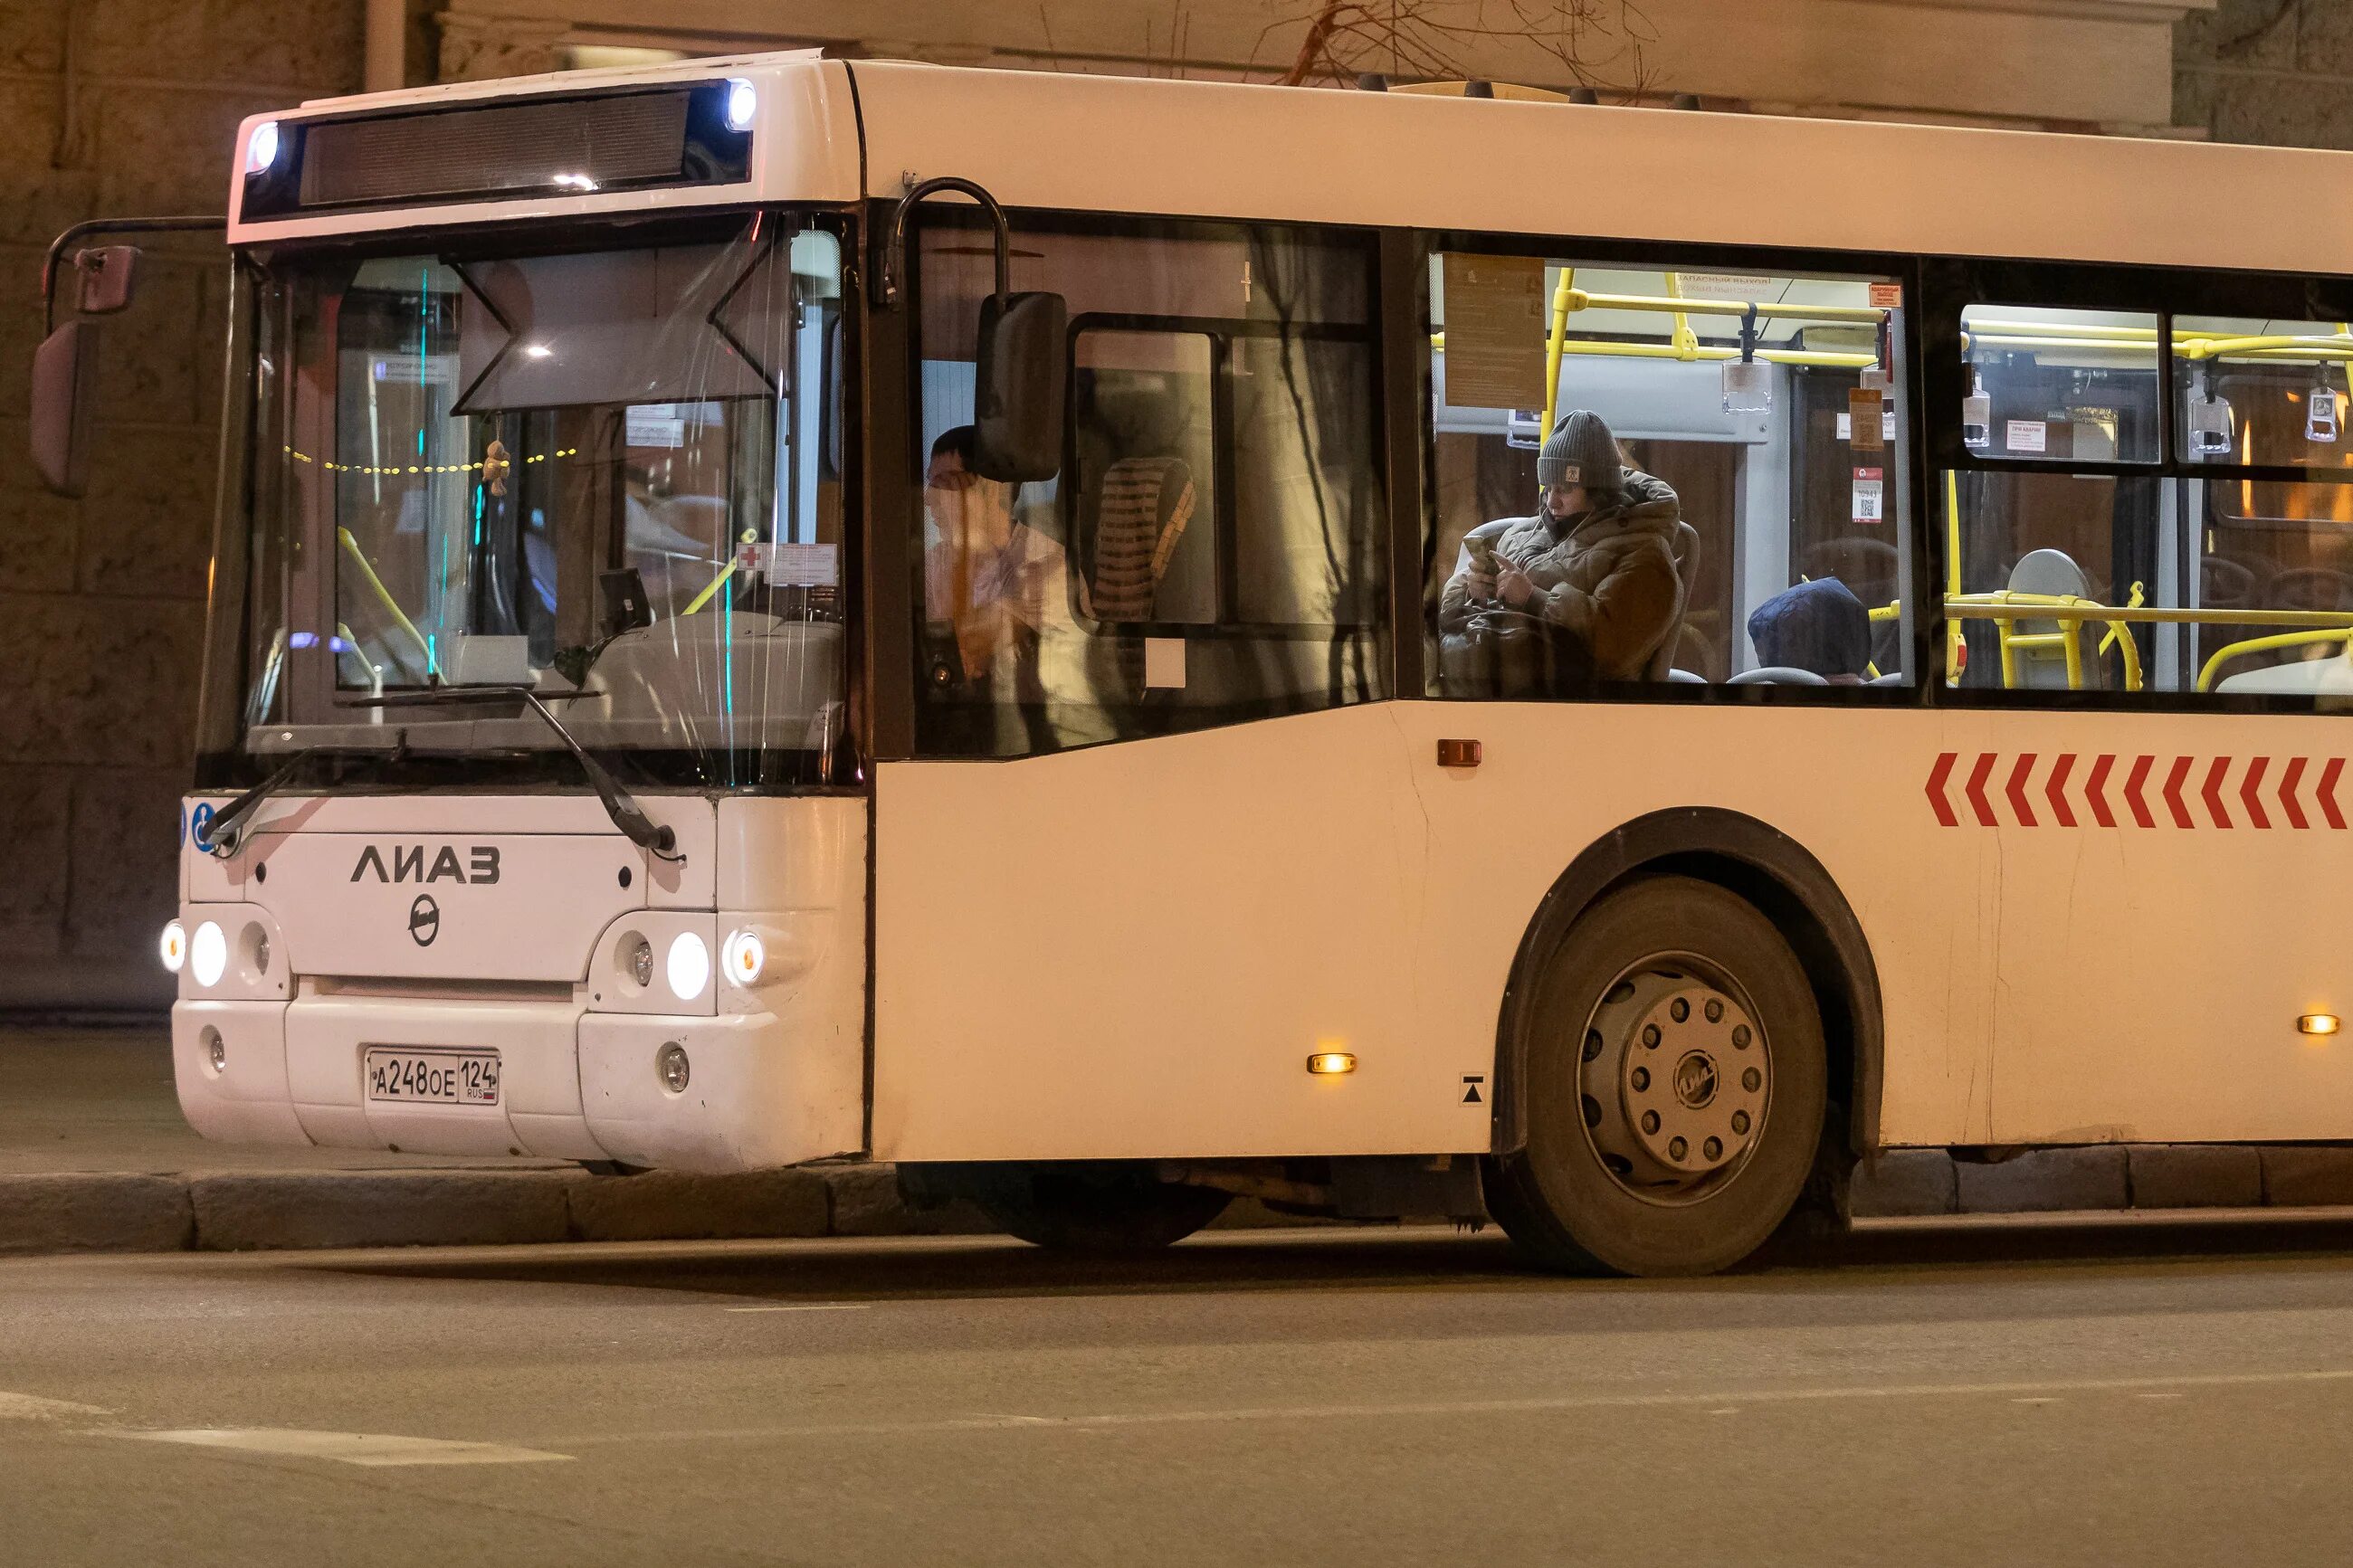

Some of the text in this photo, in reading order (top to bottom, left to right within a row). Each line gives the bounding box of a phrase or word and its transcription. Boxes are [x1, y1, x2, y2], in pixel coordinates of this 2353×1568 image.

[350, 845, 500, 884] ЛИАЗ
[461, 1060, 493, 1088] 124
[467, 1088, 483, 1098] RUS
